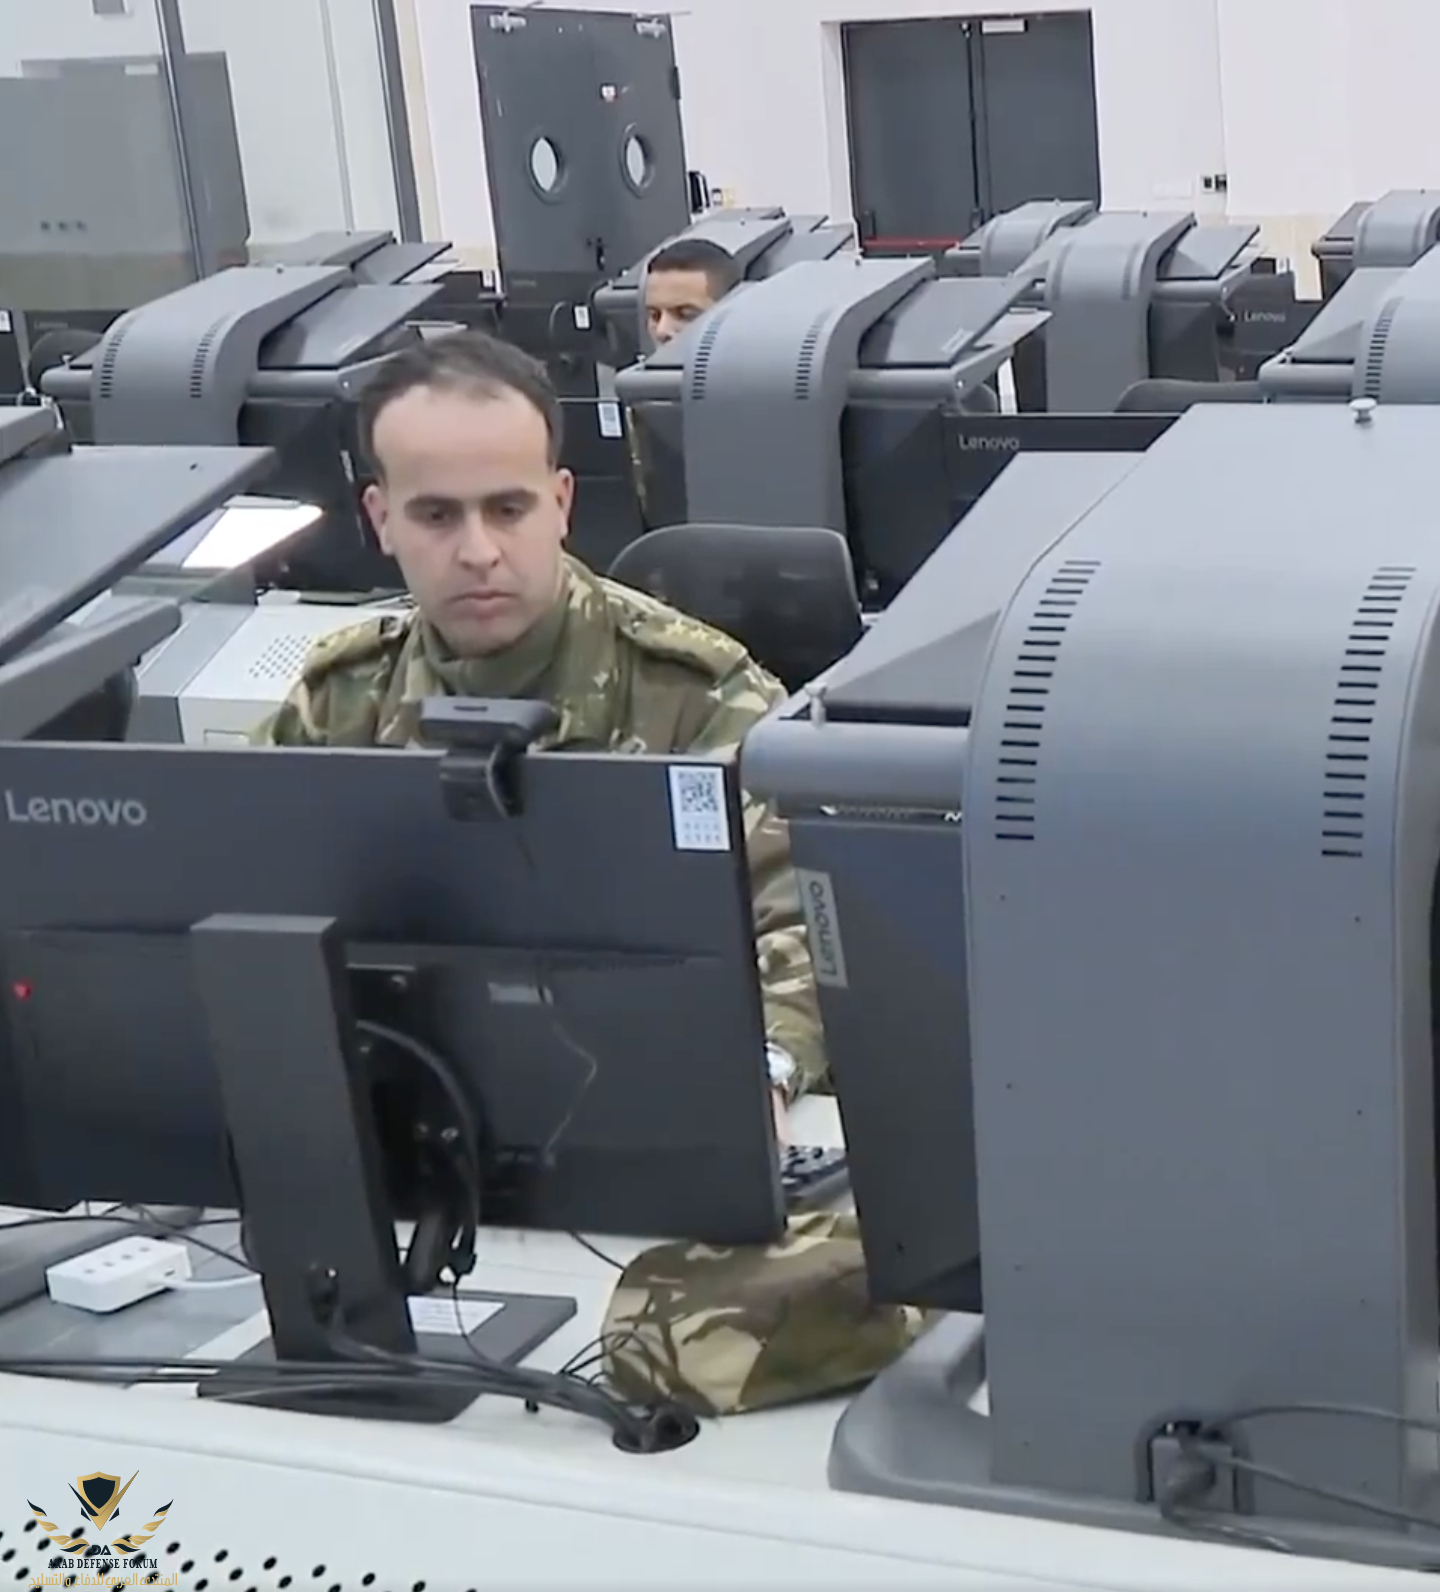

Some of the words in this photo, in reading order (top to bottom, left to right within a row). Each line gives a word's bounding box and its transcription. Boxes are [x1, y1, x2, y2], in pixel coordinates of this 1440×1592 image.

[958, 432, 1020, 451] Lenovo
[5, 789, 147, 826] Lenovo
[809, 880, 838, 976] Lenovo
